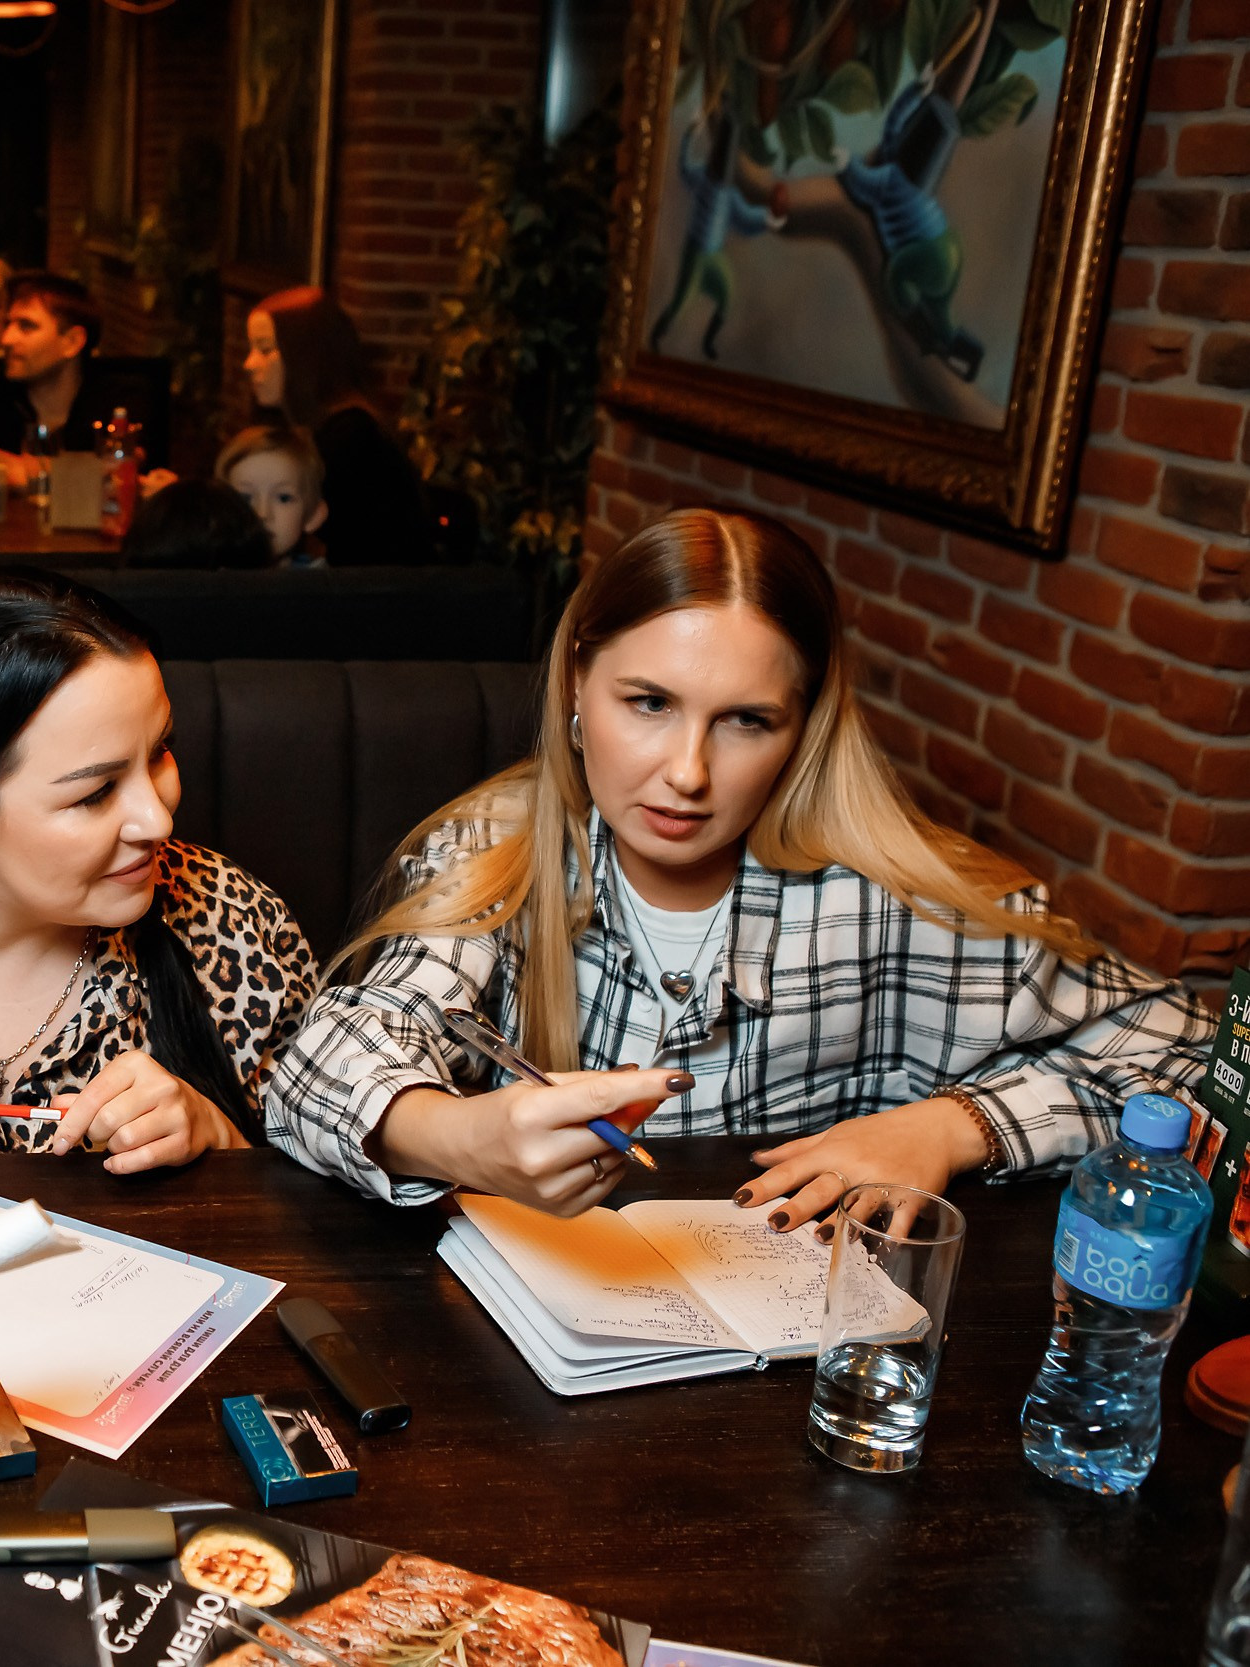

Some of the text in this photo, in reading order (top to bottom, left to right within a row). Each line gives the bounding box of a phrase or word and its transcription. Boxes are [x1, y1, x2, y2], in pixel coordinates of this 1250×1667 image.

[1231, 1039, 1239, 1057] В
[1215, 1063, 1241, 1090] 4000
[1087, 1243, 1151, 1280] bon
[1083, 1268, 1168, 1301] aqua
[186, 1324, 200, 1333] НА
[196, 1310, 214, 1325] ИЛИ
[157, 1327, 216, 1383] ПИШИ ДЛЯ ДУШИ
[160, 1333, 190, 1360] ВСЯКИЙ
[132, 1360, 164, 1387] СЛУЧАЙ
[233, 1401, 271, 1447] TEREA
[157, 1593, 225, 1667] МЕНЮ
